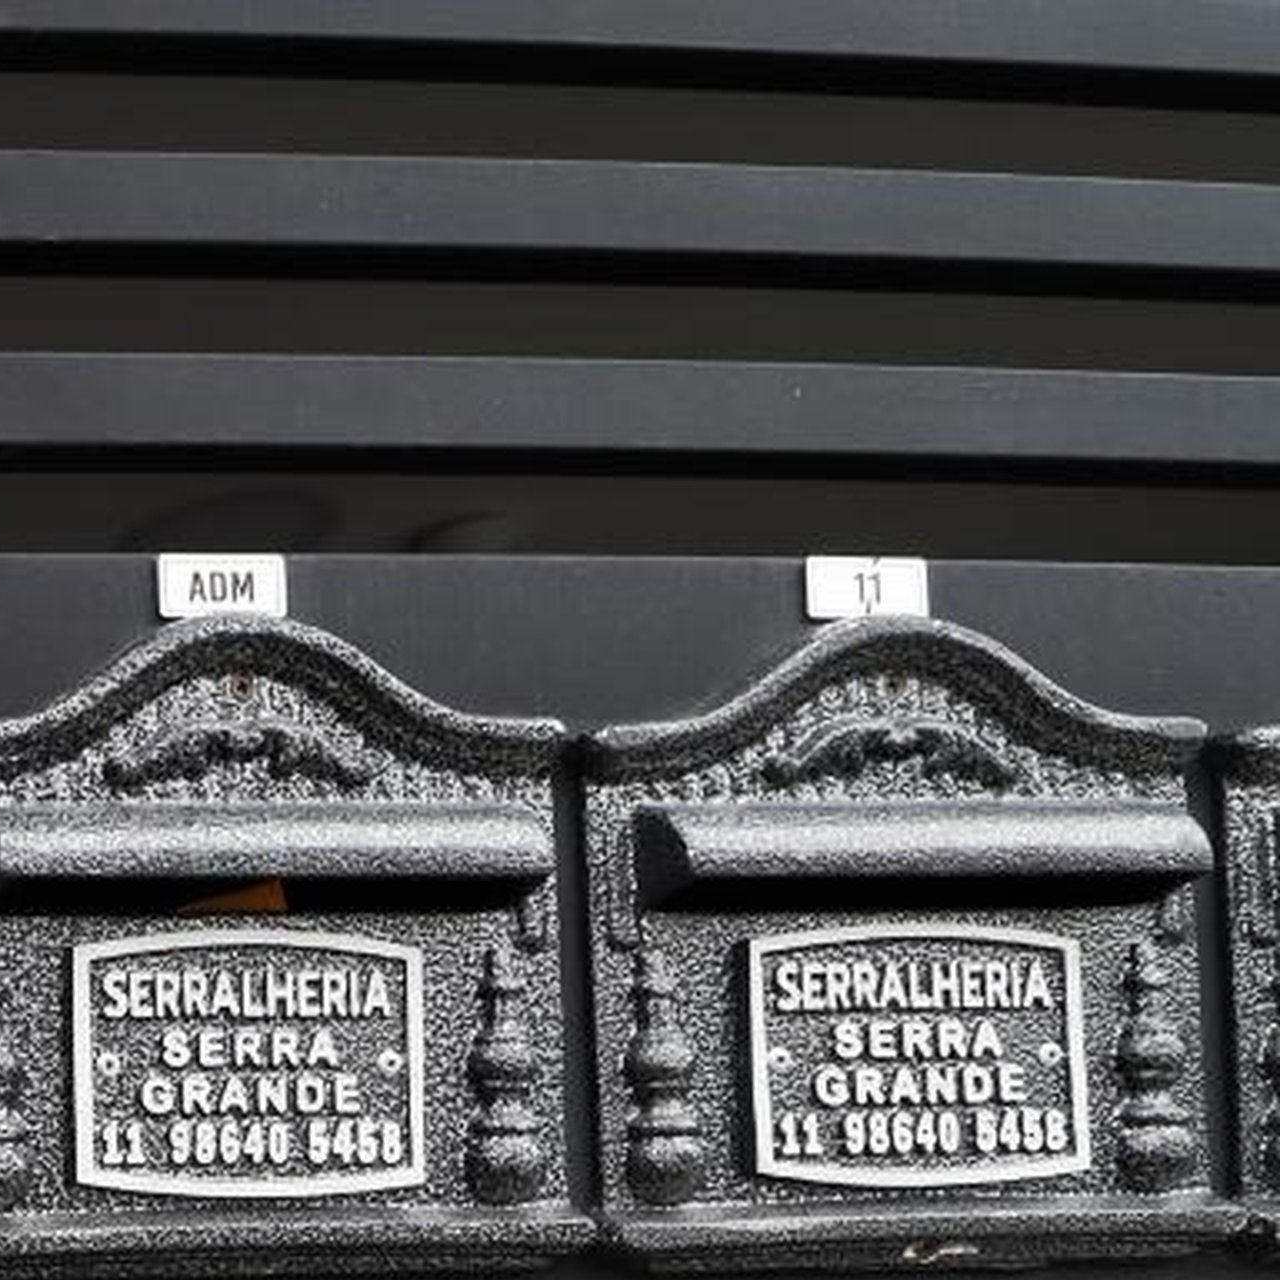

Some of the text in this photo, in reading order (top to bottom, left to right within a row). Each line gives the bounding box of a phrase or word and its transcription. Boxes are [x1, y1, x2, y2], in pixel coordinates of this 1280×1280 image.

[189, 569, 257, 605] ADM
[852, 572, 881, 604] 11
[102, 967, 391, 1020] SERRALHERIA
[775, 961, 1053, 1011] SERRALHERIA
[162, 1028, 340, 1068] SERRA
[836, 1022, 1004, 1060] SERRA
[141, 1075, 361, 1114] GRANDE
[816, 1067, 1027, 1104] GRANDE
[102, 1120, 146, 1165] 11
[170, 1121, 289, 1164] 98640
[780, 1112, 824, 1155] 11
[844, 1111, 960, 1153] 98640
